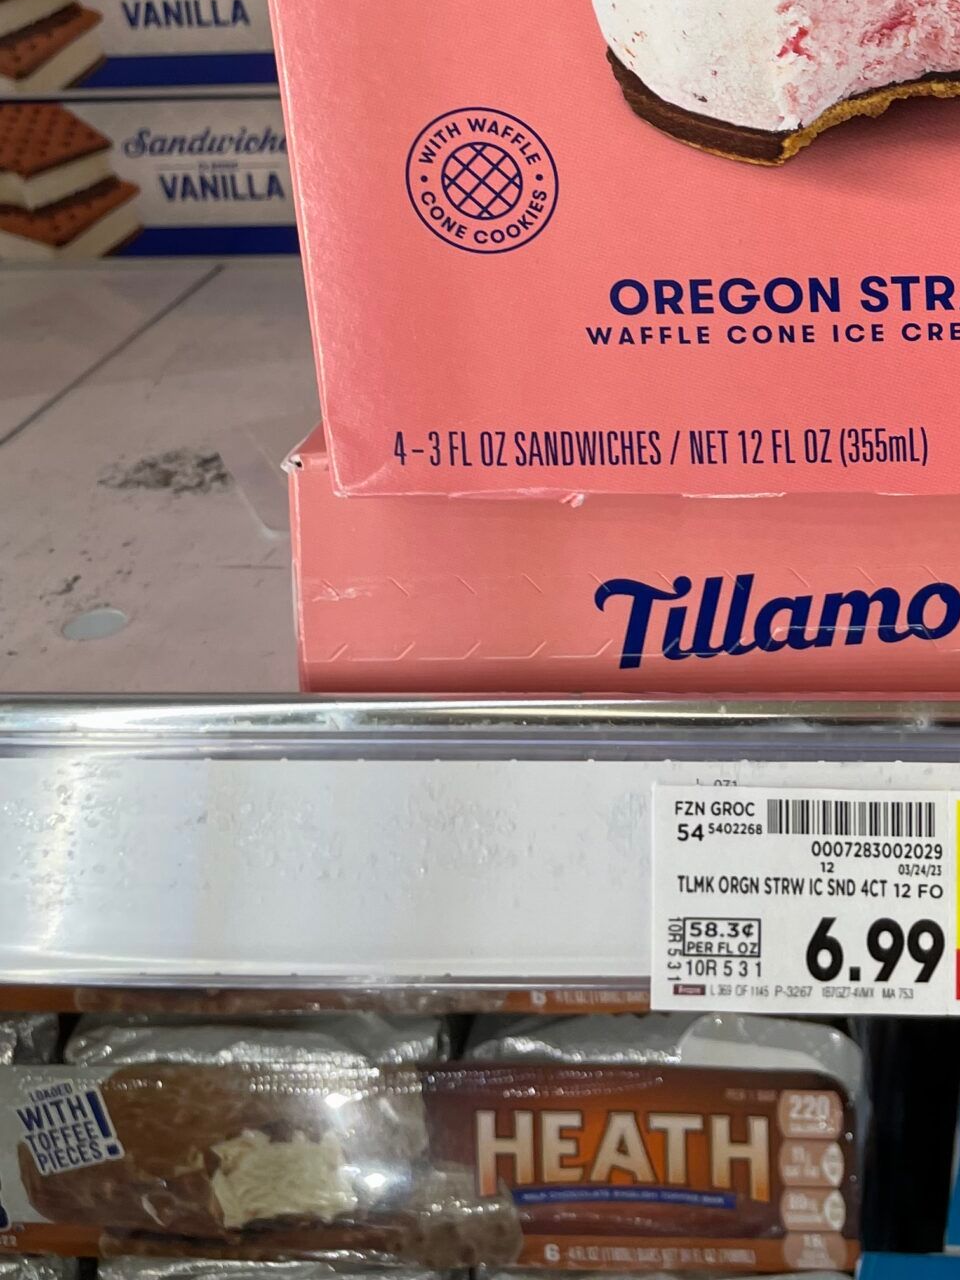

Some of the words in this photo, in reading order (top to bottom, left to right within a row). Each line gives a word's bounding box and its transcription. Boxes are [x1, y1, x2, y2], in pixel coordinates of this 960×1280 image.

[418, 122, 462, 165] WITH
[466, 117, 542, 166] WAFFLE
[159, 171, 285, 202] VANILLA
[421, 191, 468, 239] CONE
[473, 189, 547, 244] COOKIES
[609, 275, 841, 316] OREGON
[586, 324, 711, 346] WAFFLE
[727, 323, 816, 345] CONE
[832, 323, 885, 343] ICE
[449, 431, 473, 467] FL
[480, 431, 508, 467] OZ
[515, 430, 662, 466] SANDWICHES
[690, 430, 729, 465] NET
[738, 430, 763, 465] 12
[772, 429, 797, 464] FL
[804, 429, 833, 464] OZ
[839, 426, 929, 467] (355mL)
[674, 801, 705, 816] FZN
[711, 802, 755, 817] GROC
[677, 823, 704, 842] 54
[708, 823, 763, 835] 5402268
[811, 841, 943, 860] 0007283002029
[820, 862, 834, 873] 12
[898, 864, 942, 877] 03/24/23
[677, 875, 714, 893] TLMK
[718, 876, 760, 894] ORGN
[764, 877, 804, 895] STRW
[809, 878, 823, 895] IC
[827, 879, 856, 896] SND
[861, 879, 887, 897] 4CT
[894, 884, 911, 898] 12
[918, 884, 943, 899] FO
[690, 922, 755, 938] 58.3¢
[687, 942, 713, 954] PER
[718, 942, 733, 954] FL
[738, 942, 758, 954] OZ
[806, 917, 945, 982] 6.99
[686, 960, 717, 976] 10R
[774, 985, 813, 998] P-3267
[29, 1082, 73, 1103] LOADED
[16, 1094, 88, 1132] WITH
[25, 1120, 99, 1153] TOFFEE
[475, 1110, 770, 1204] HEATH
[788, 1094, 830, 1121] 220
